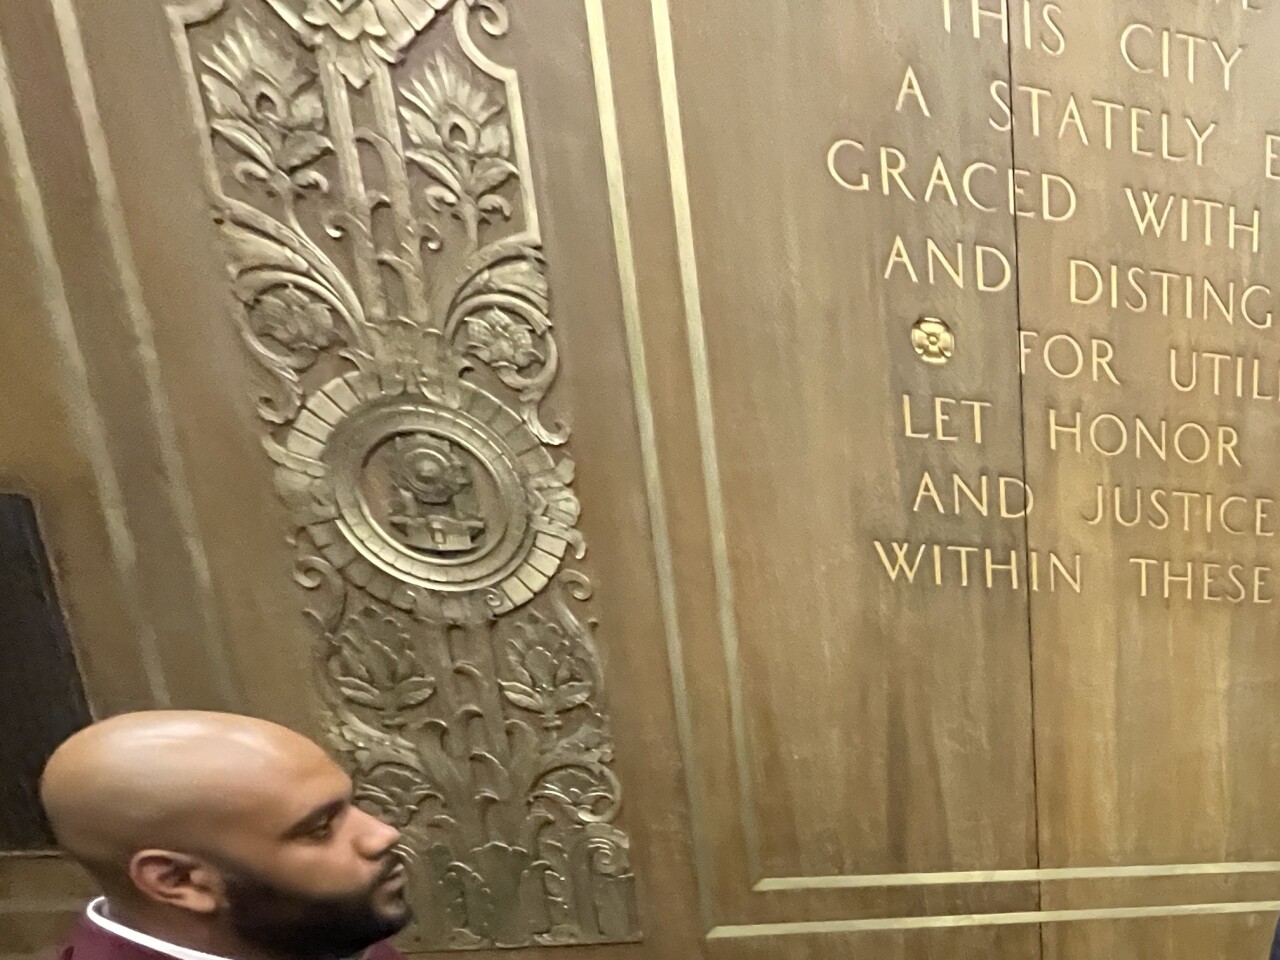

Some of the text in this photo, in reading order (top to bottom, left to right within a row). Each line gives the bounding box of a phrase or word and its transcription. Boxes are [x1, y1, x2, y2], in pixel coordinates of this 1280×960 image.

[1120, 23, 1247, 92] CITY
[895, 65, 931, 118] A
[988, 79, 1217, 167] STATELY
[826, 139, 1077, 223] GRACED
[1124, 187, 1261, 254] WITH
[884, 236, 1012, 294] AND
[1020, 331, 1121, 386] FOR
[903, 394, 992, 444] LET
[1048, 409, 1242, 467] HONOR
[912, 472, 1035, 520] AND
[1081, 485, 1275, 538] JUSTICE
[872, 541, 1083, 595] WITHIN
[1128, 558, 1273, 605] THESE
